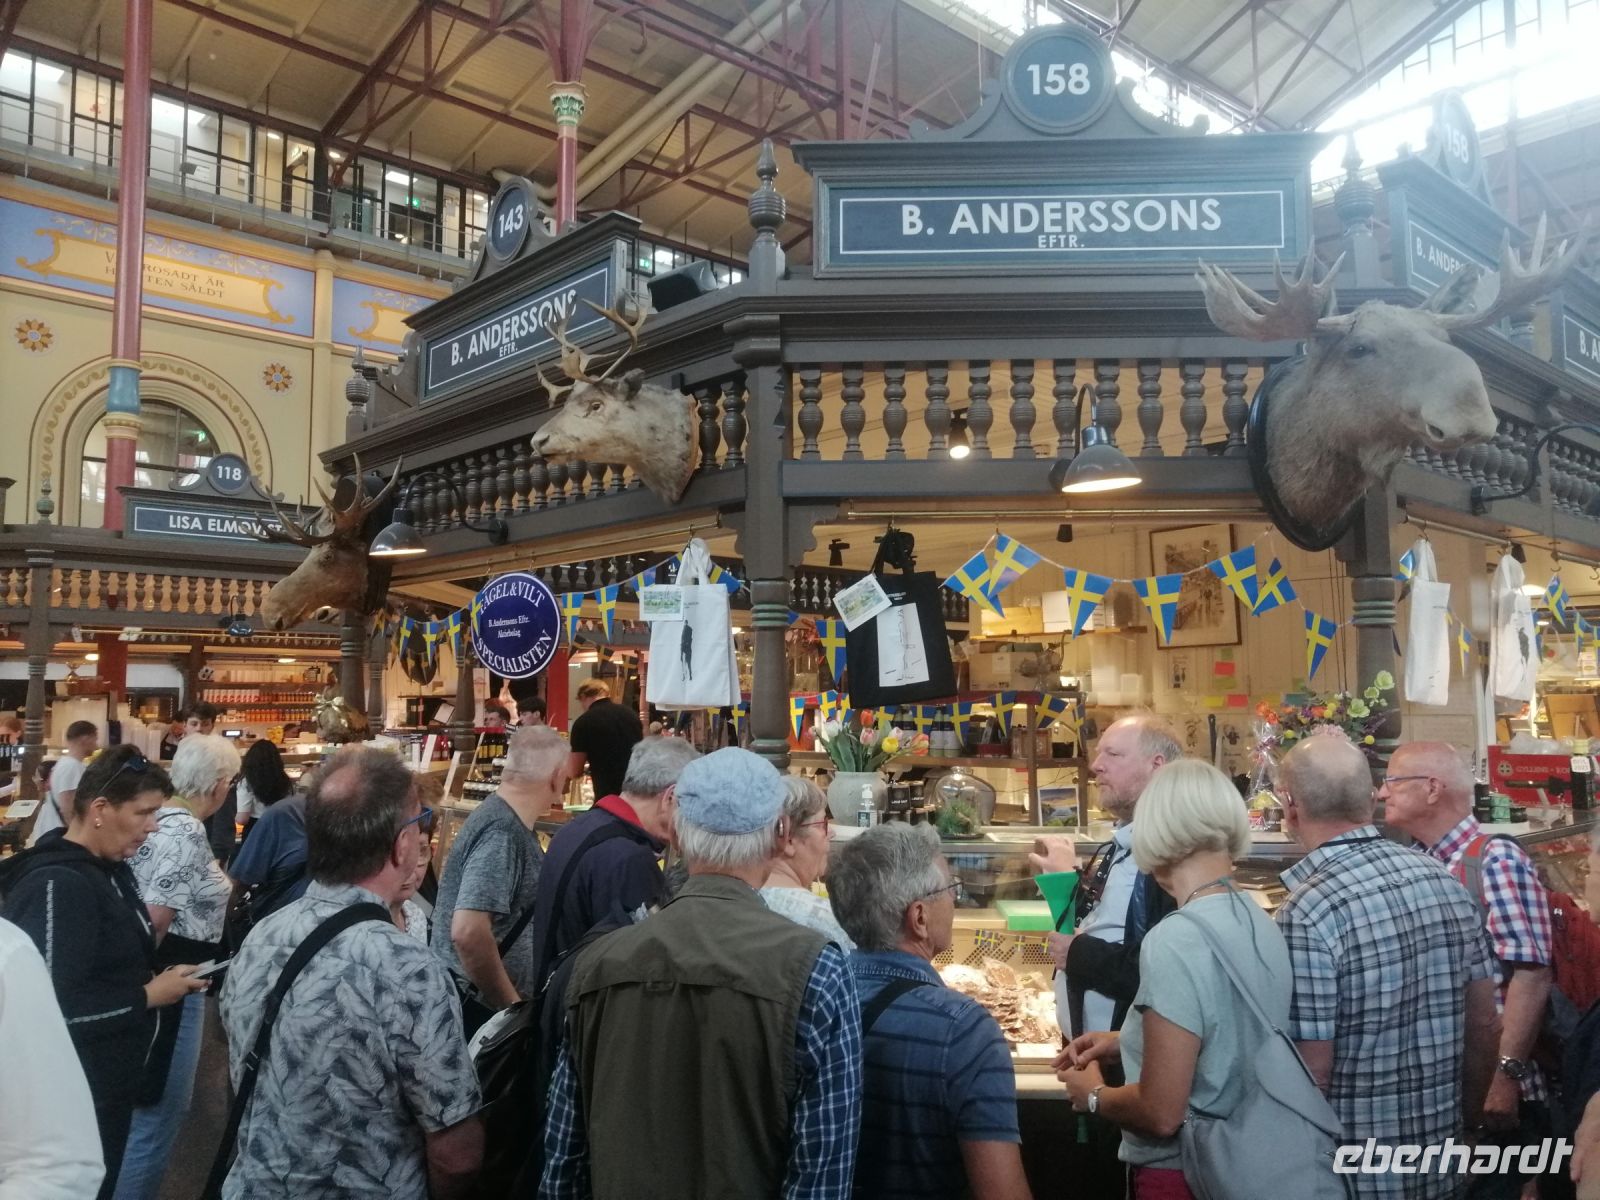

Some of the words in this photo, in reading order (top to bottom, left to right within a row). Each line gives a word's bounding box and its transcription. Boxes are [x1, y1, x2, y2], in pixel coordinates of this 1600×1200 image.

[1026, 62, 1091, 96] 158
[1445, 122, 1469, 164] 158
[498, 203, 524, 239] 143
[901, 203, 934, 236] B.
[949, 198, 1223, 235] ANDERSSONS
[1037, 233, 1086, 249] EFTR.
[451, 342, 463, 366] B.
[468, 289, 577, 360] ANDERSSONS
[499, 341, 519, 358] EFTR.
[216, 465, 242, 481] 118
[169, 514, 203, 531] LISA
[476, 629, 552, 673] SPECIALISTEN
